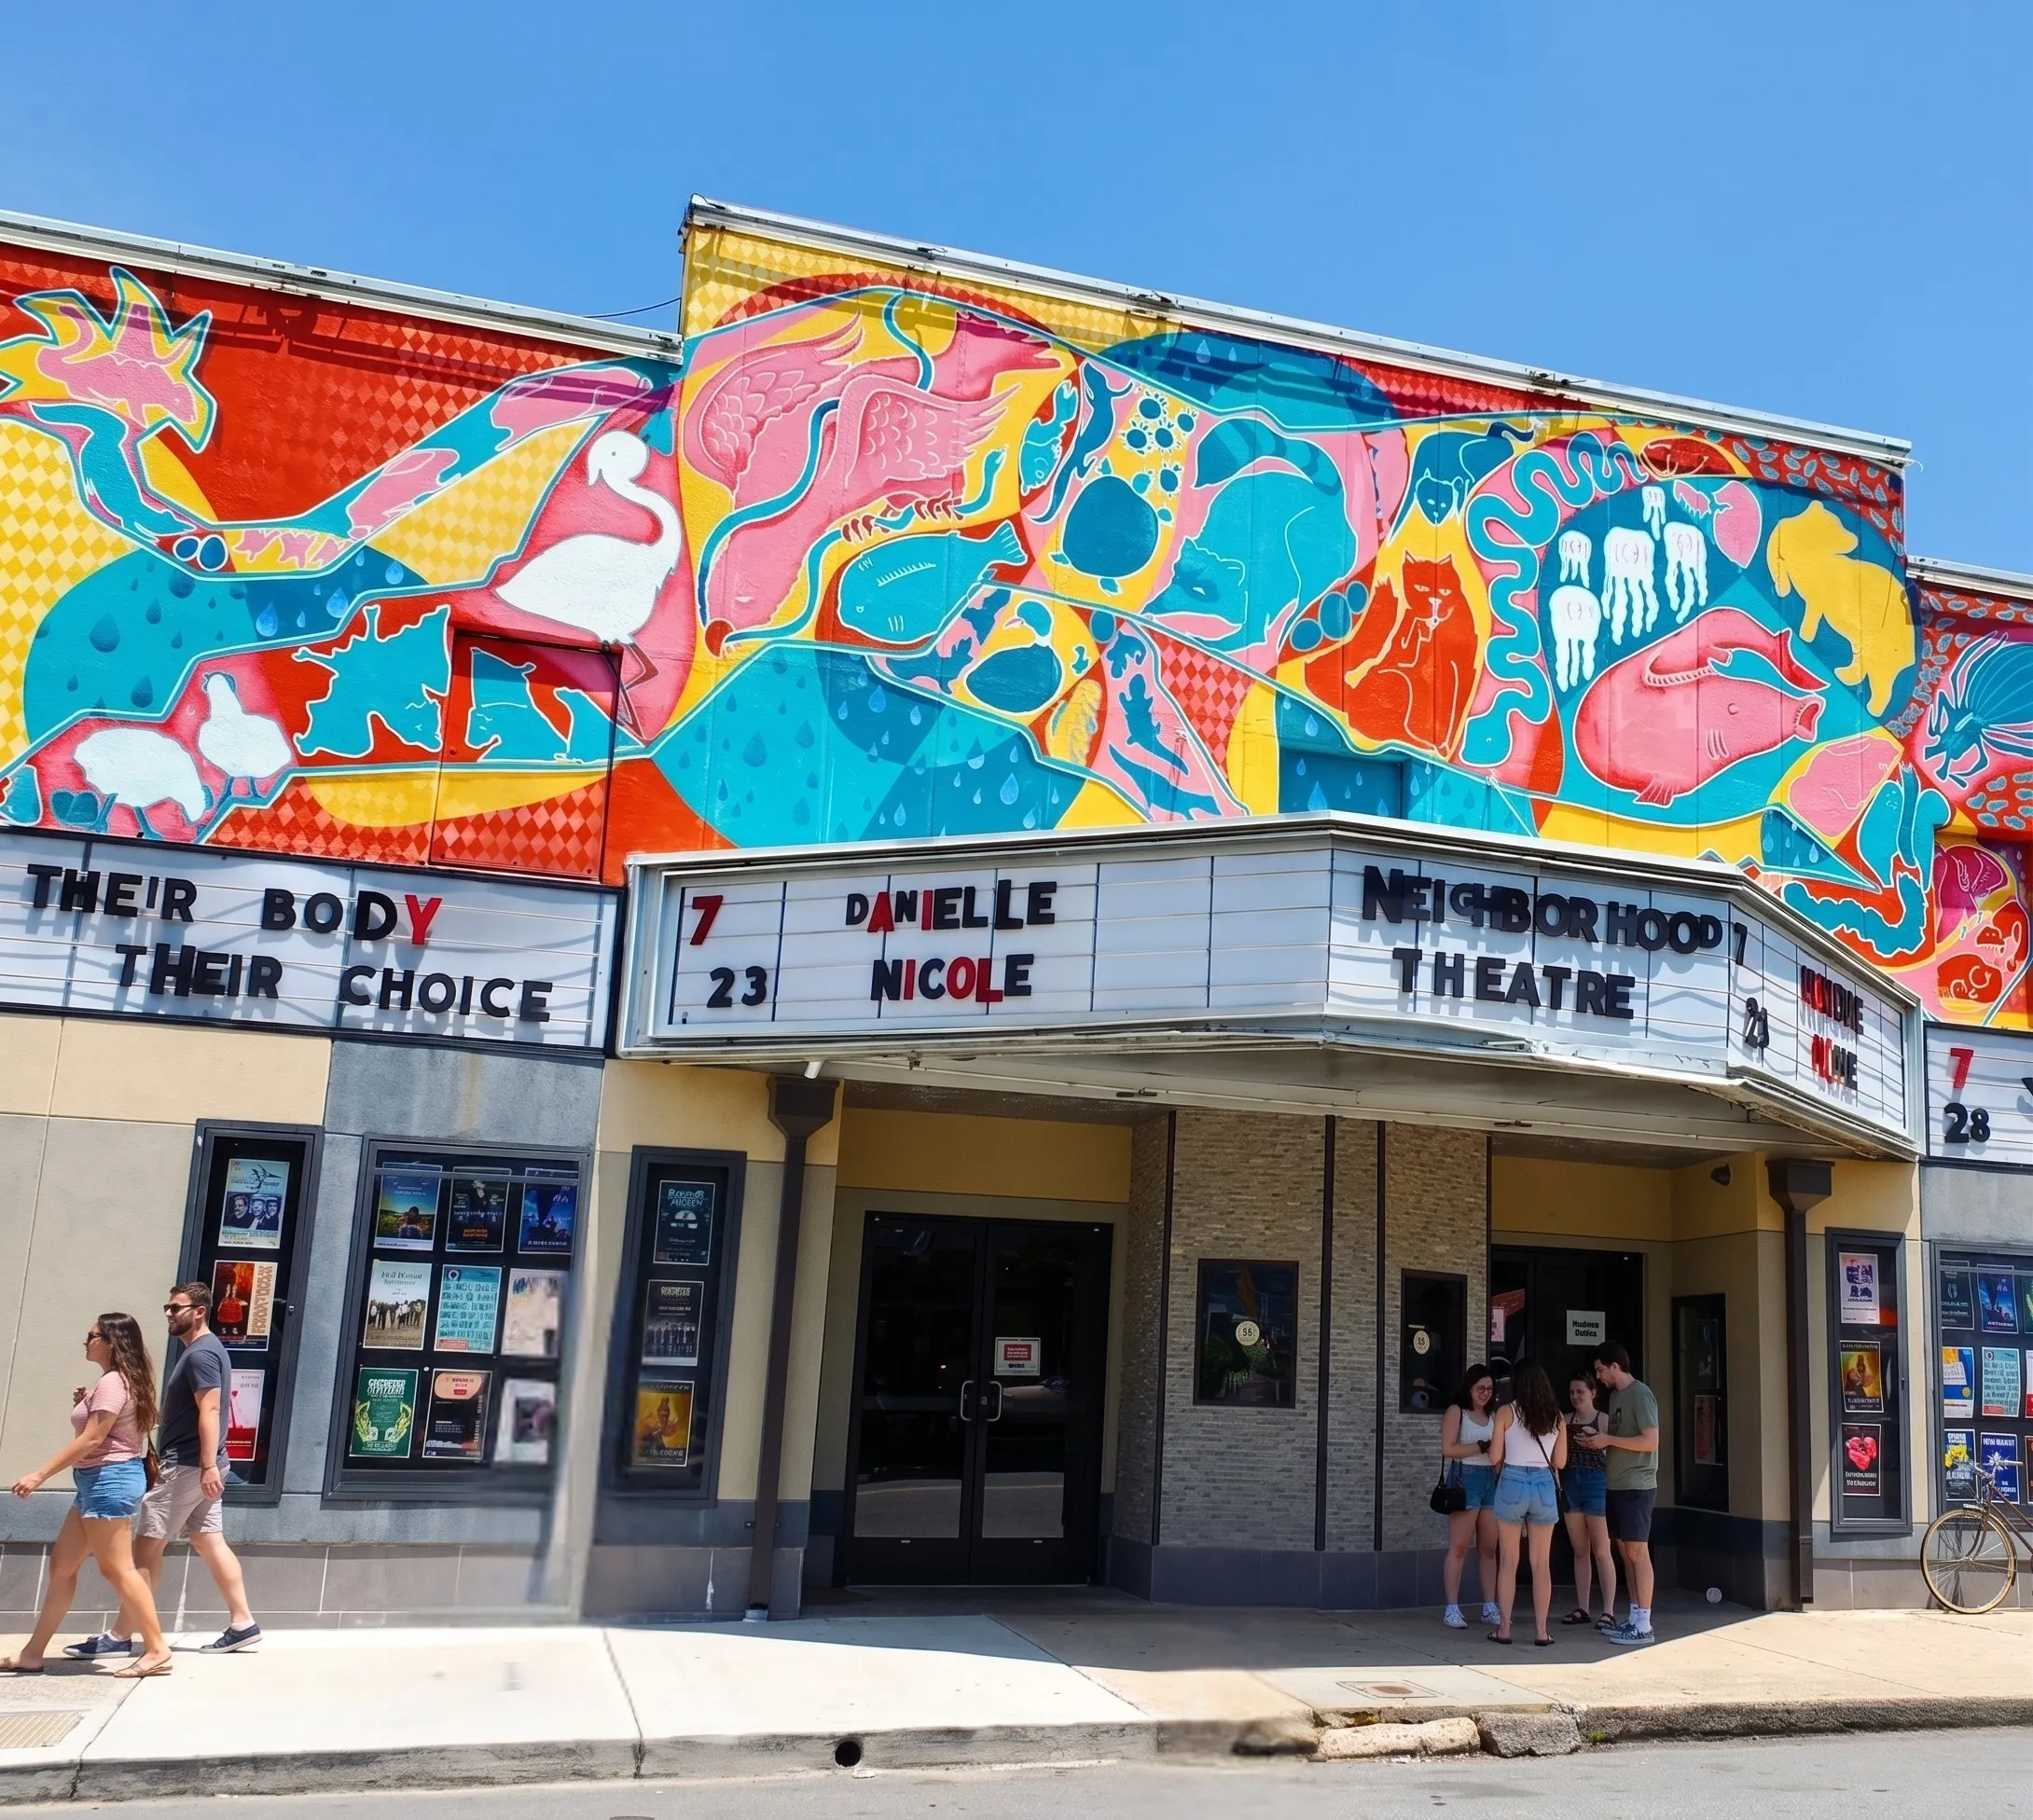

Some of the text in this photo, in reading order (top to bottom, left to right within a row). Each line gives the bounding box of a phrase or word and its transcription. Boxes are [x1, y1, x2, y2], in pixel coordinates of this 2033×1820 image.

[27, 862, 443, 946] THEIR BODY
[689, 894, 724, 946] 7
[845, 878, 1058, 933] DANIELLE
[1362, 864, 1723, 956] NEIGHBORHOOD
[115, 943, 554, 1024] THEIR CHOICE
[706, 964, 768, 1009] 23
[870, 953, 1035, 1003] NICOLE
[1392, 946, 1636, 1020] THEATRE
[1950, 1047, 1974, 1089] 7
[1943, 1102, 1991, 1144] 28
